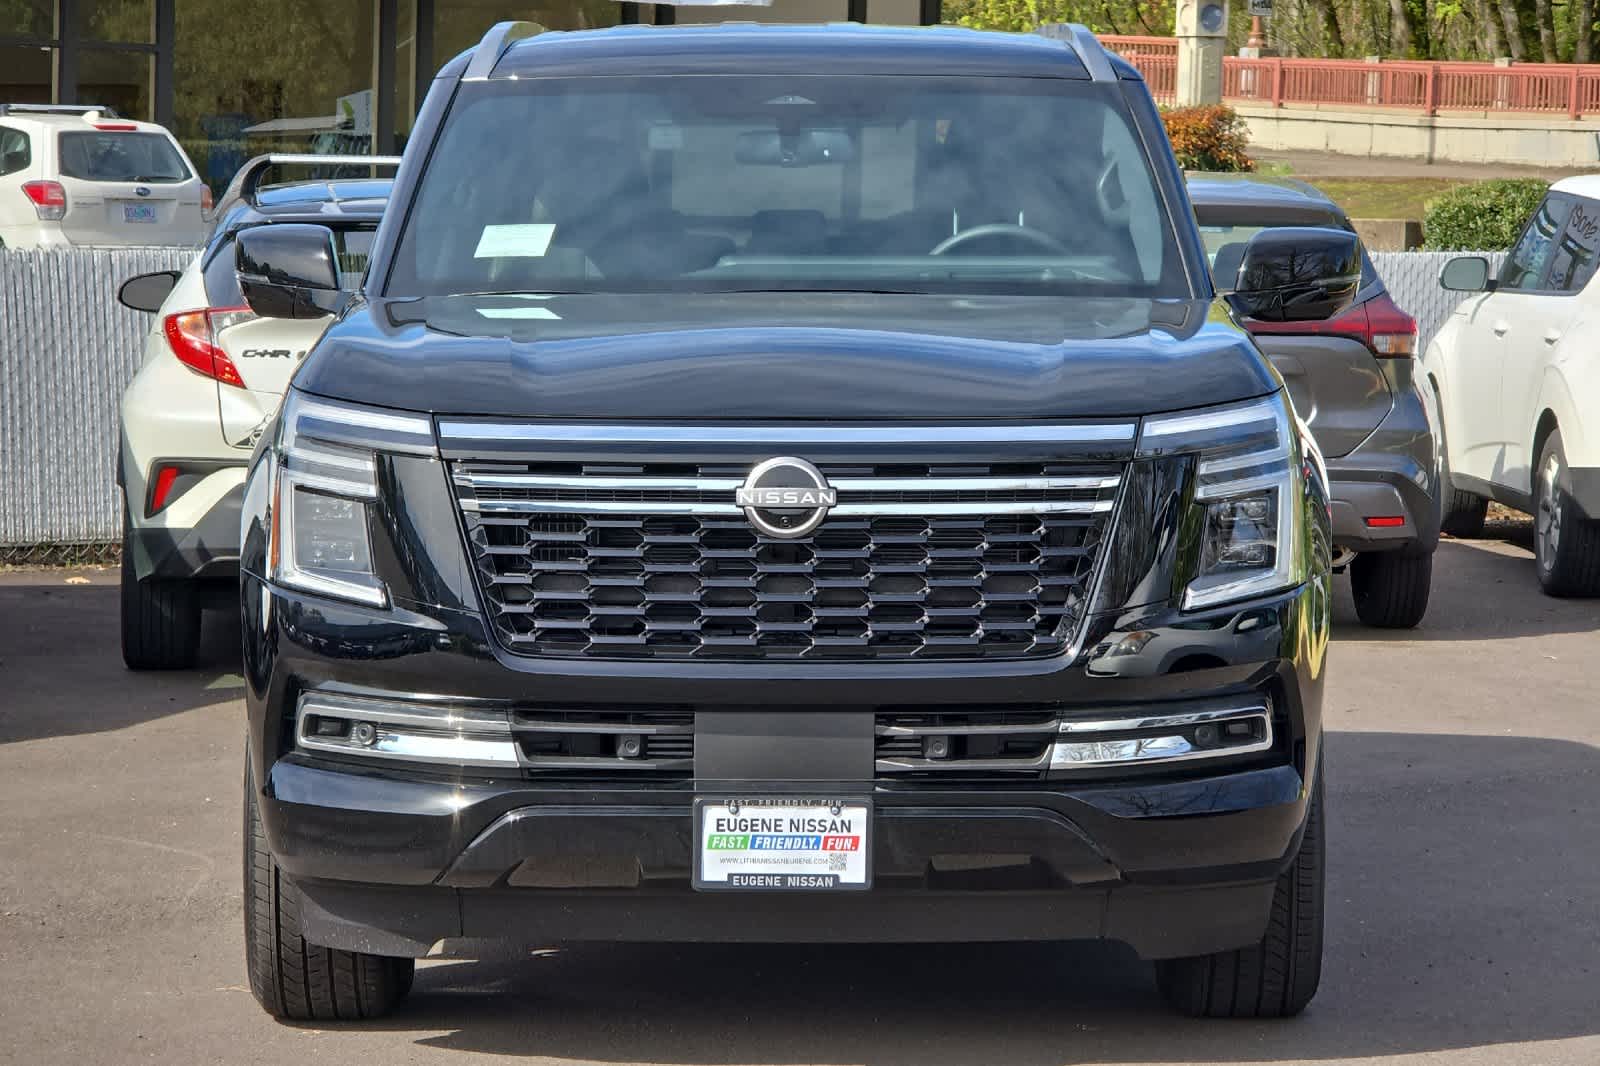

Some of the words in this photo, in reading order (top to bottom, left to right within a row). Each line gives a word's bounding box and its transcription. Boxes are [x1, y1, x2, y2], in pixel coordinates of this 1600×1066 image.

[739, 491, 835, 504] NISSAN
[715, 818, 784, 833] EUGENE
[789, 819, 852, 833] NISSAN
[711, 836, 746, 849] FAST.
[754, 836, 818, 850] FRIENDLY.
[826, 837, 856, 850] FUN.
[732, 875, 782, 887] EUGENE
[787, 876, 834, 887] NISSAN
